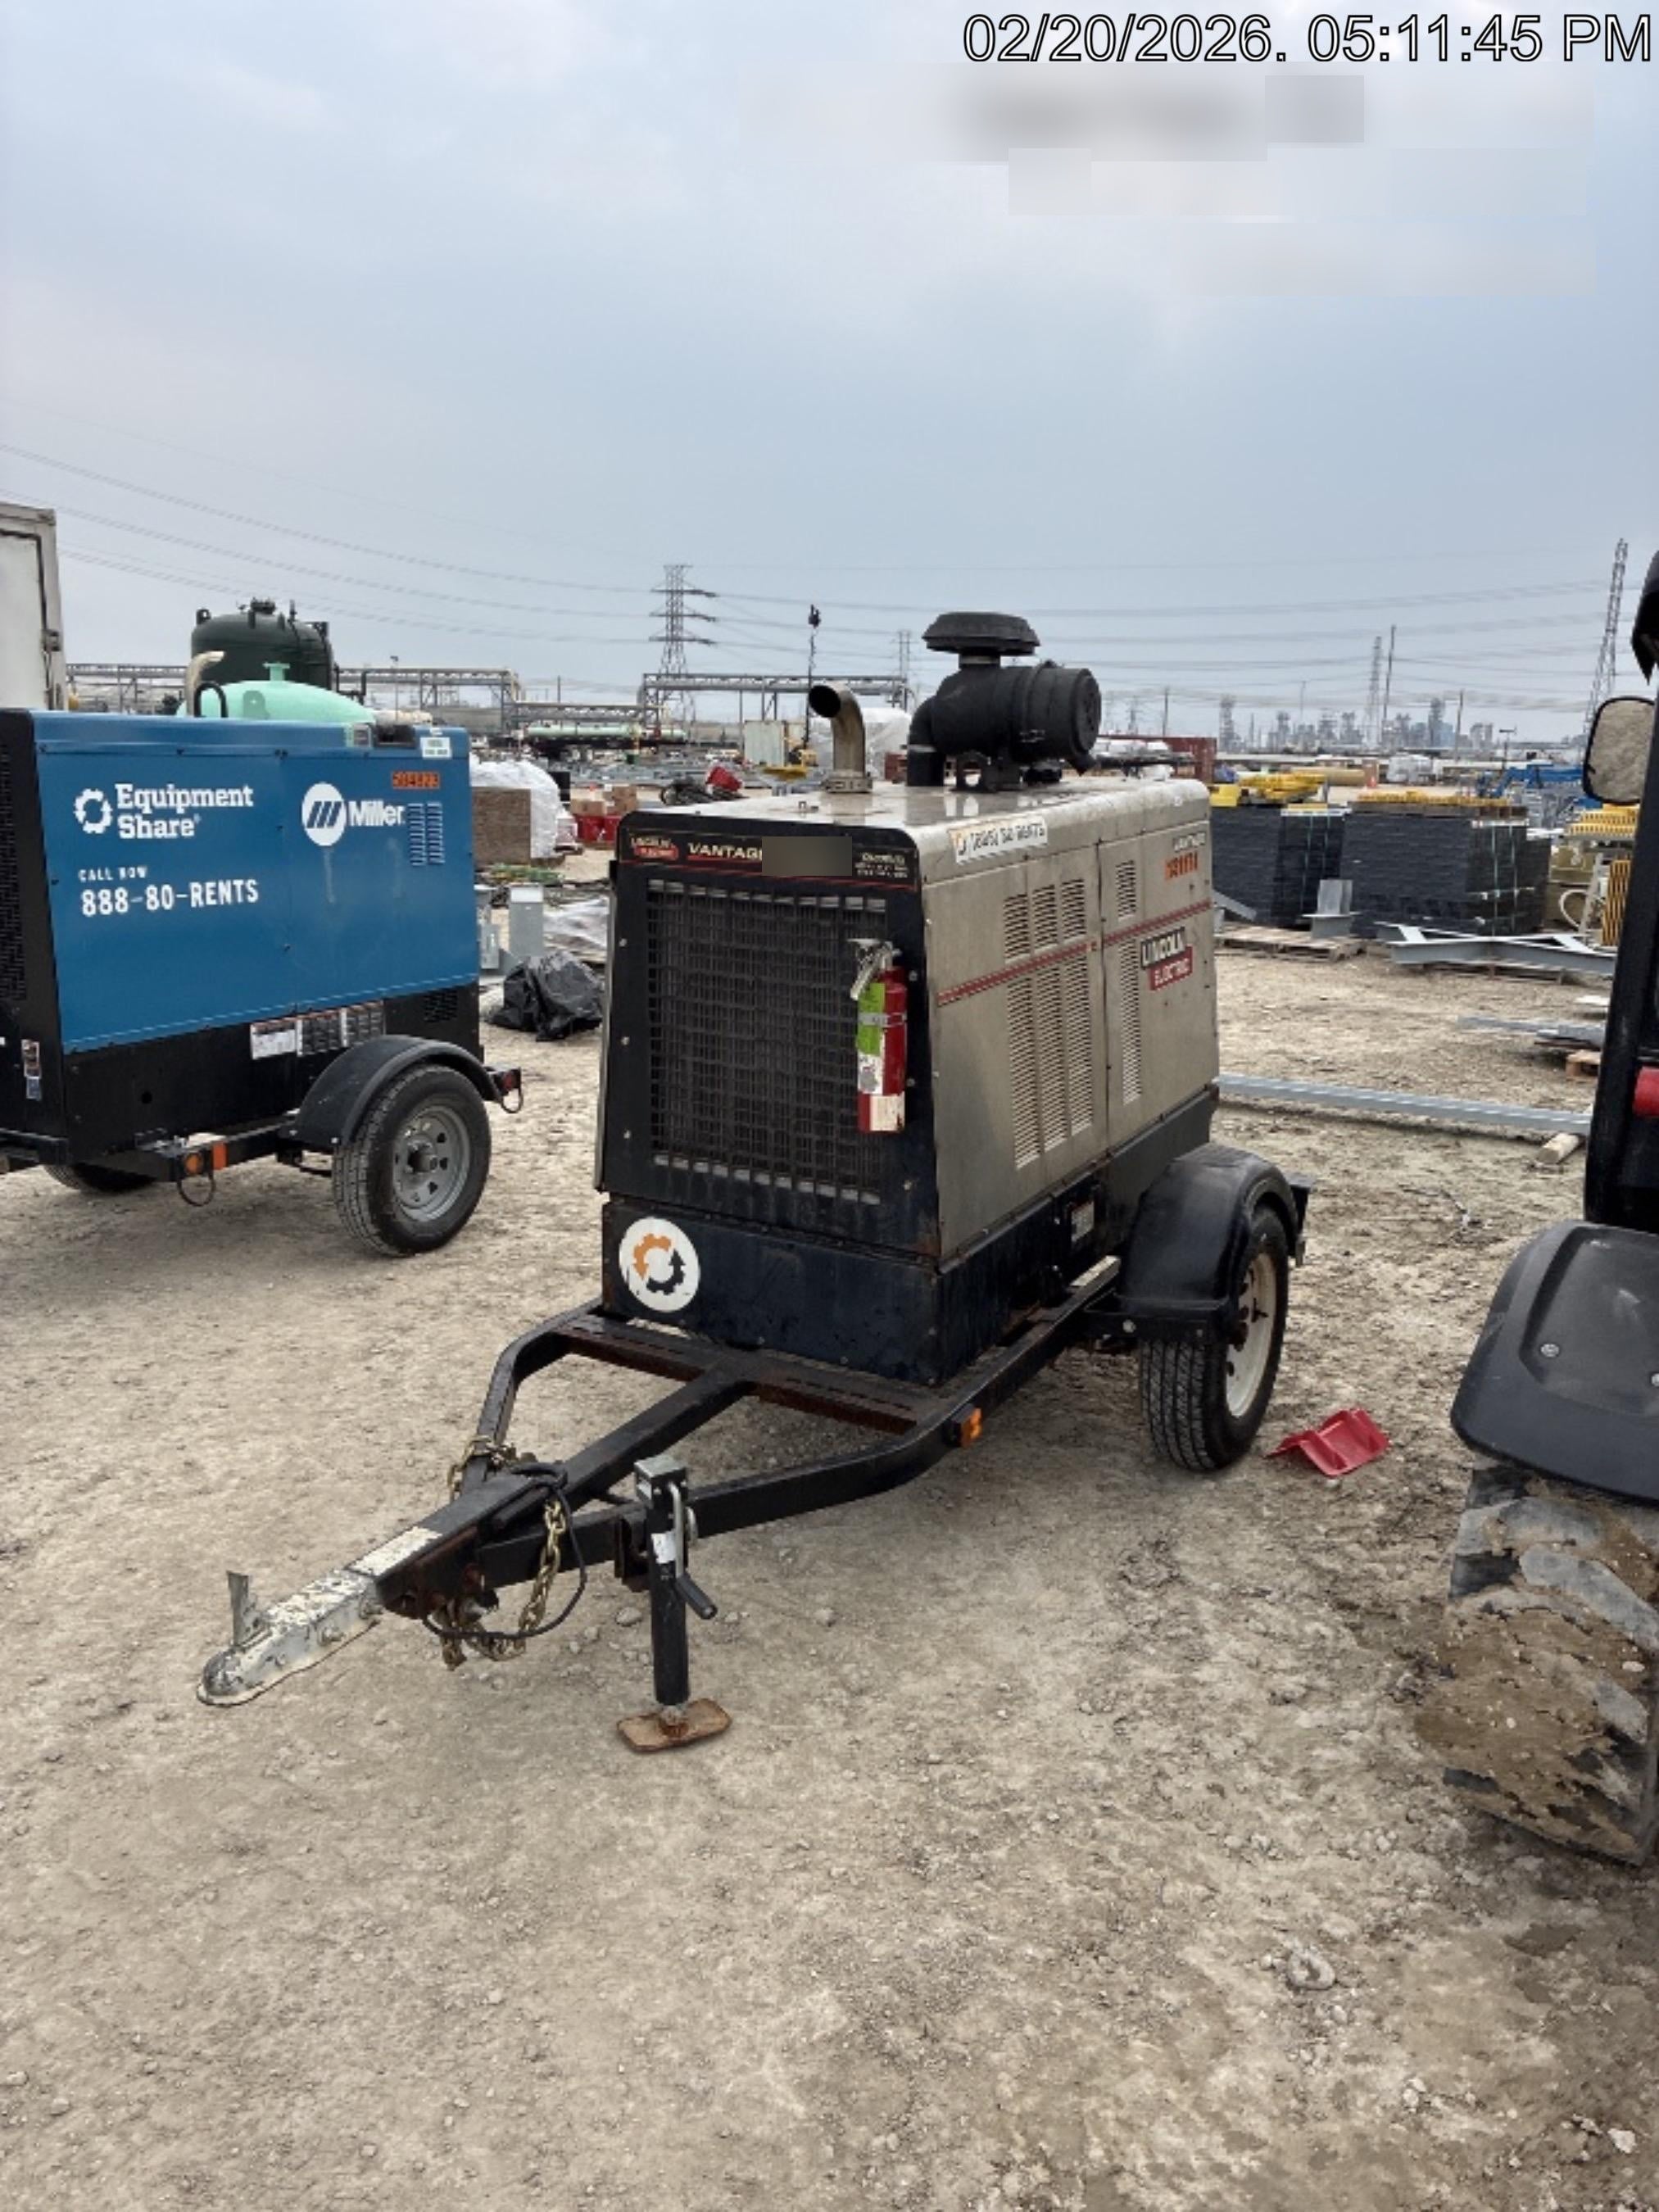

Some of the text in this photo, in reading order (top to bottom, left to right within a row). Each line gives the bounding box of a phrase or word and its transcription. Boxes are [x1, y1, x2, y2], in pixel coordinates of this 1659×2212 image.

[115, 784, 253, 814] Equipment
[117, 814, 195, 839] Share
[348, 800, 405, 827] Miller
[688, 843, 762, 860] VANTAG
[78, 866, 147, 882] CALL NOW
[81, 879, 259, 917] 888-80-RENTS
